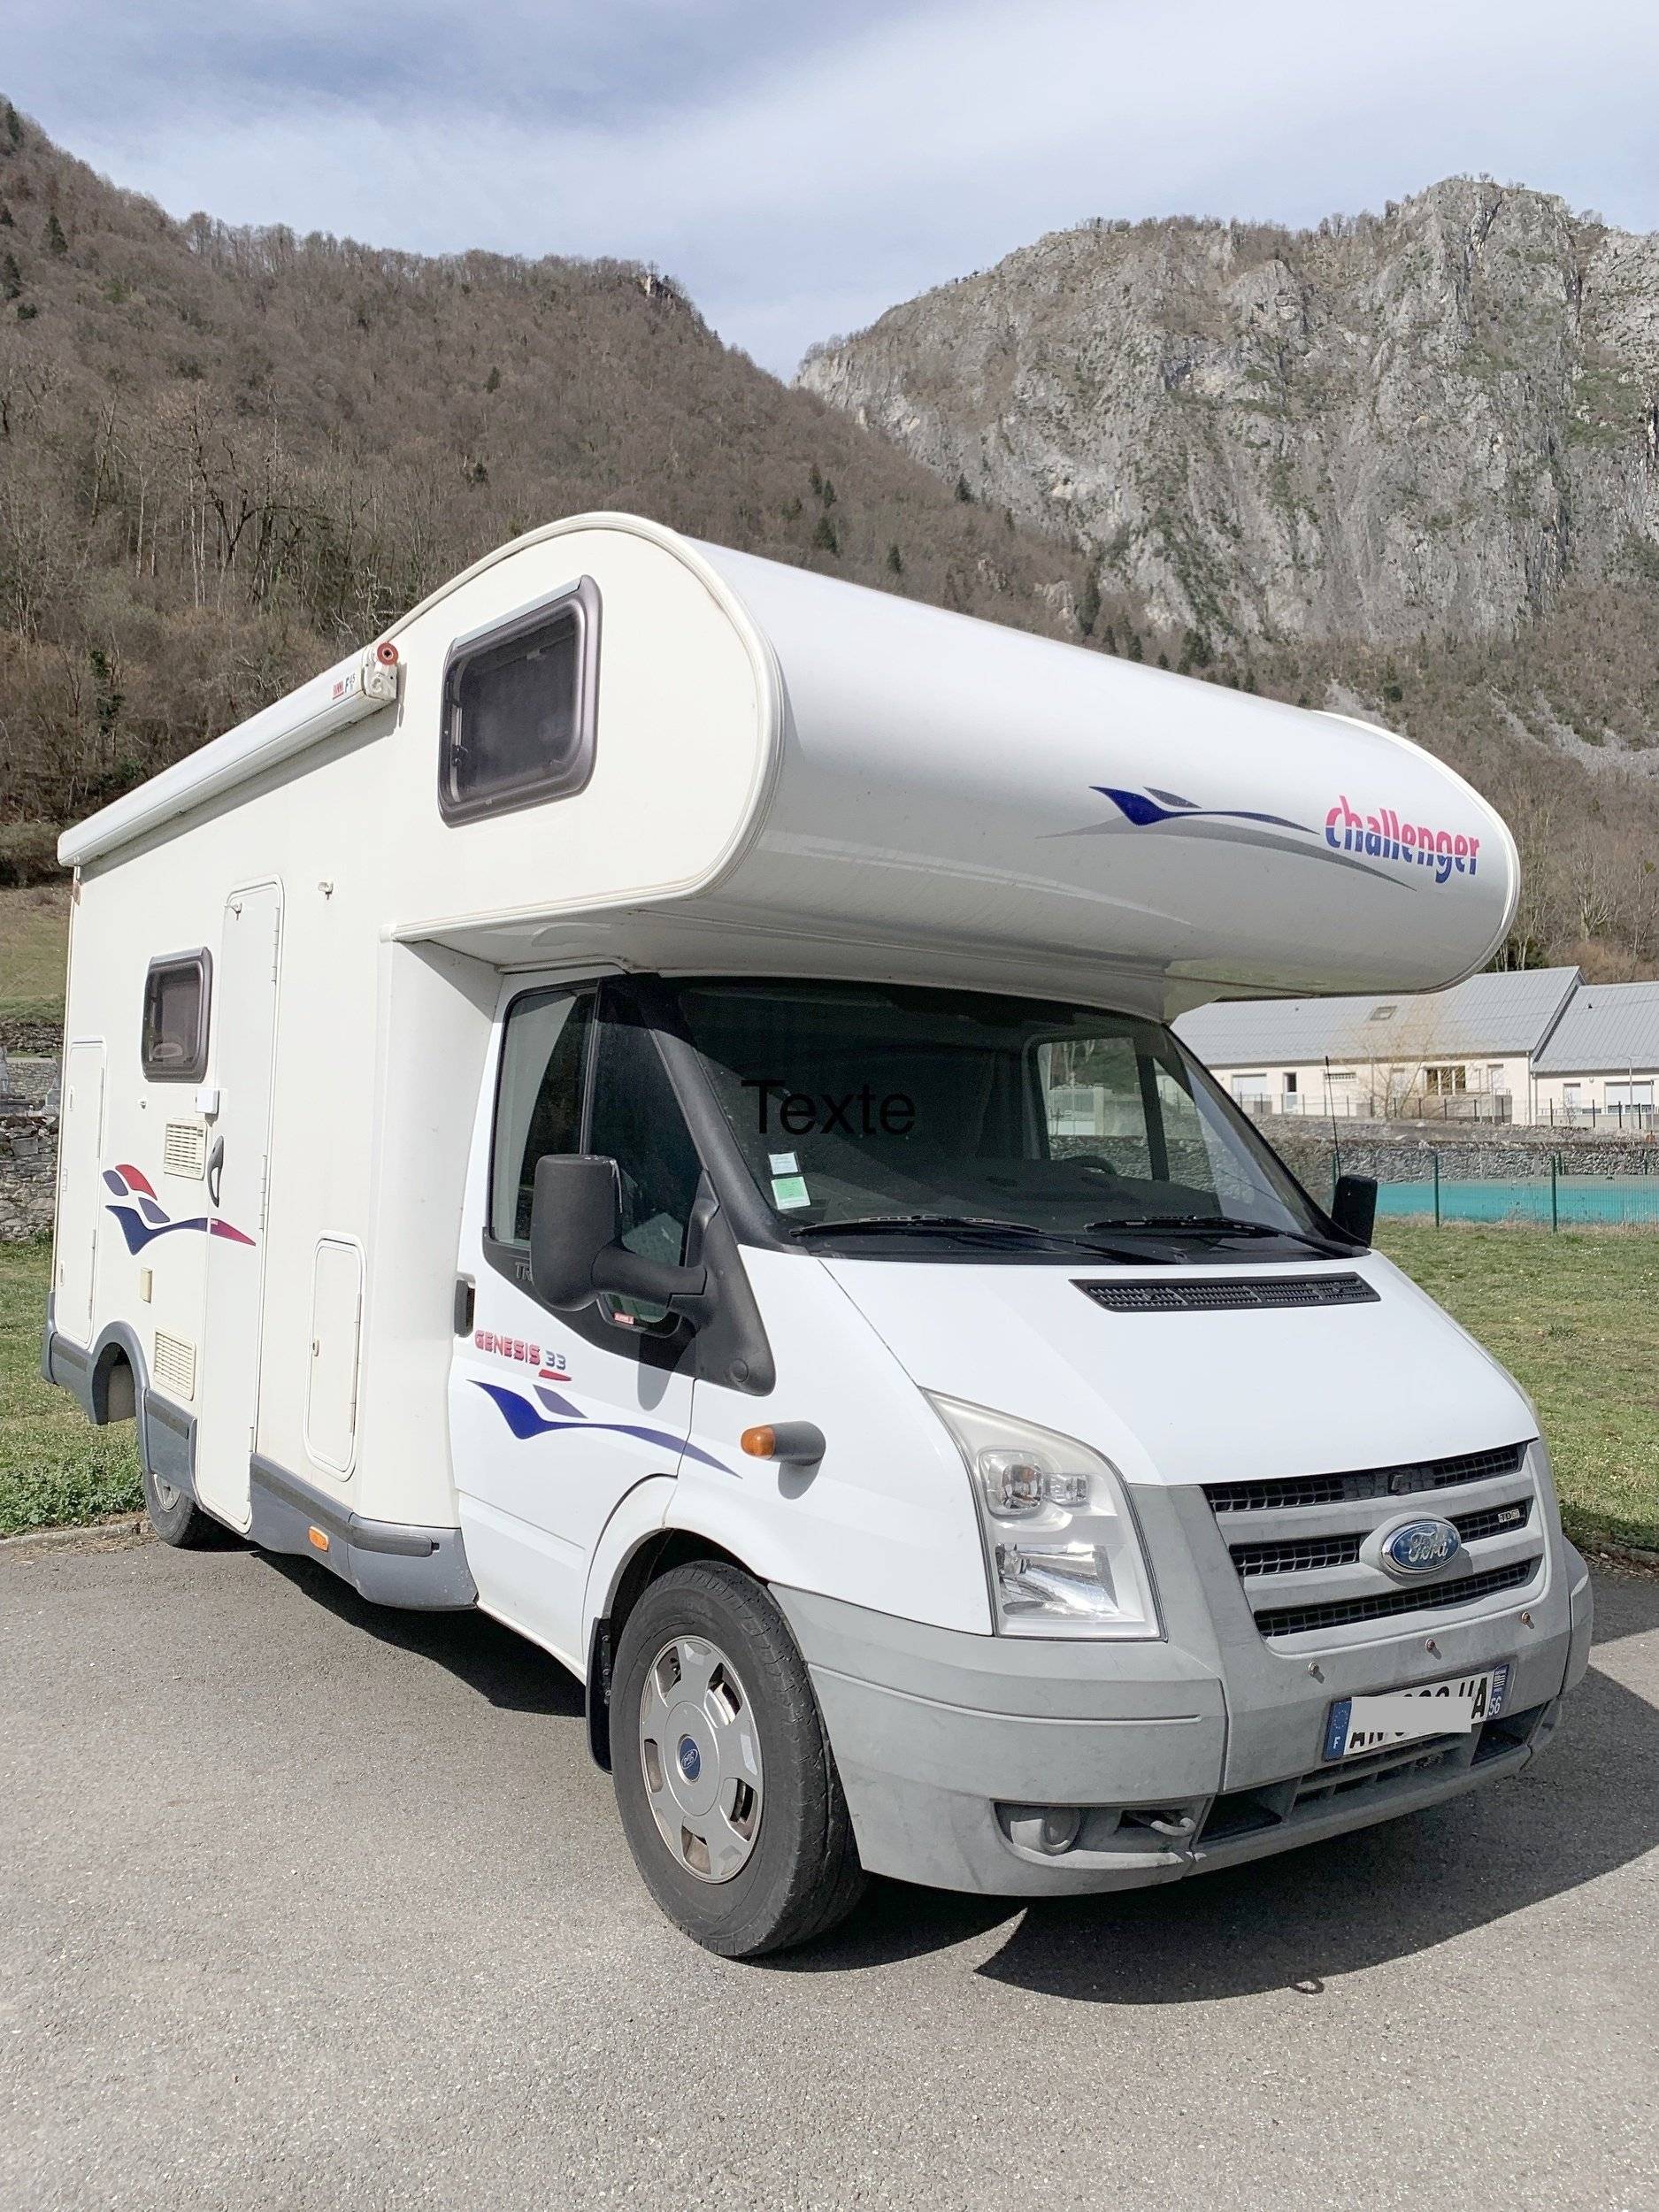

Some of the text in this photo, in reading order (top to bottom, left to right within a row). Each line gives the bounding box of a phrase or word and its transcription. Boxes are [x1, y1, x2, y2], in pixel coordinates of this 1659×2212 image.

[1325, 795, 1480, 883] challenger
[474, 1329, 567, 1371] GENESIS 33
[1409, 1532, 1449, 1563] Ford
[1488, 1696, 1502, 1717] 56
[1333, 1735, 1341, 1749] F
